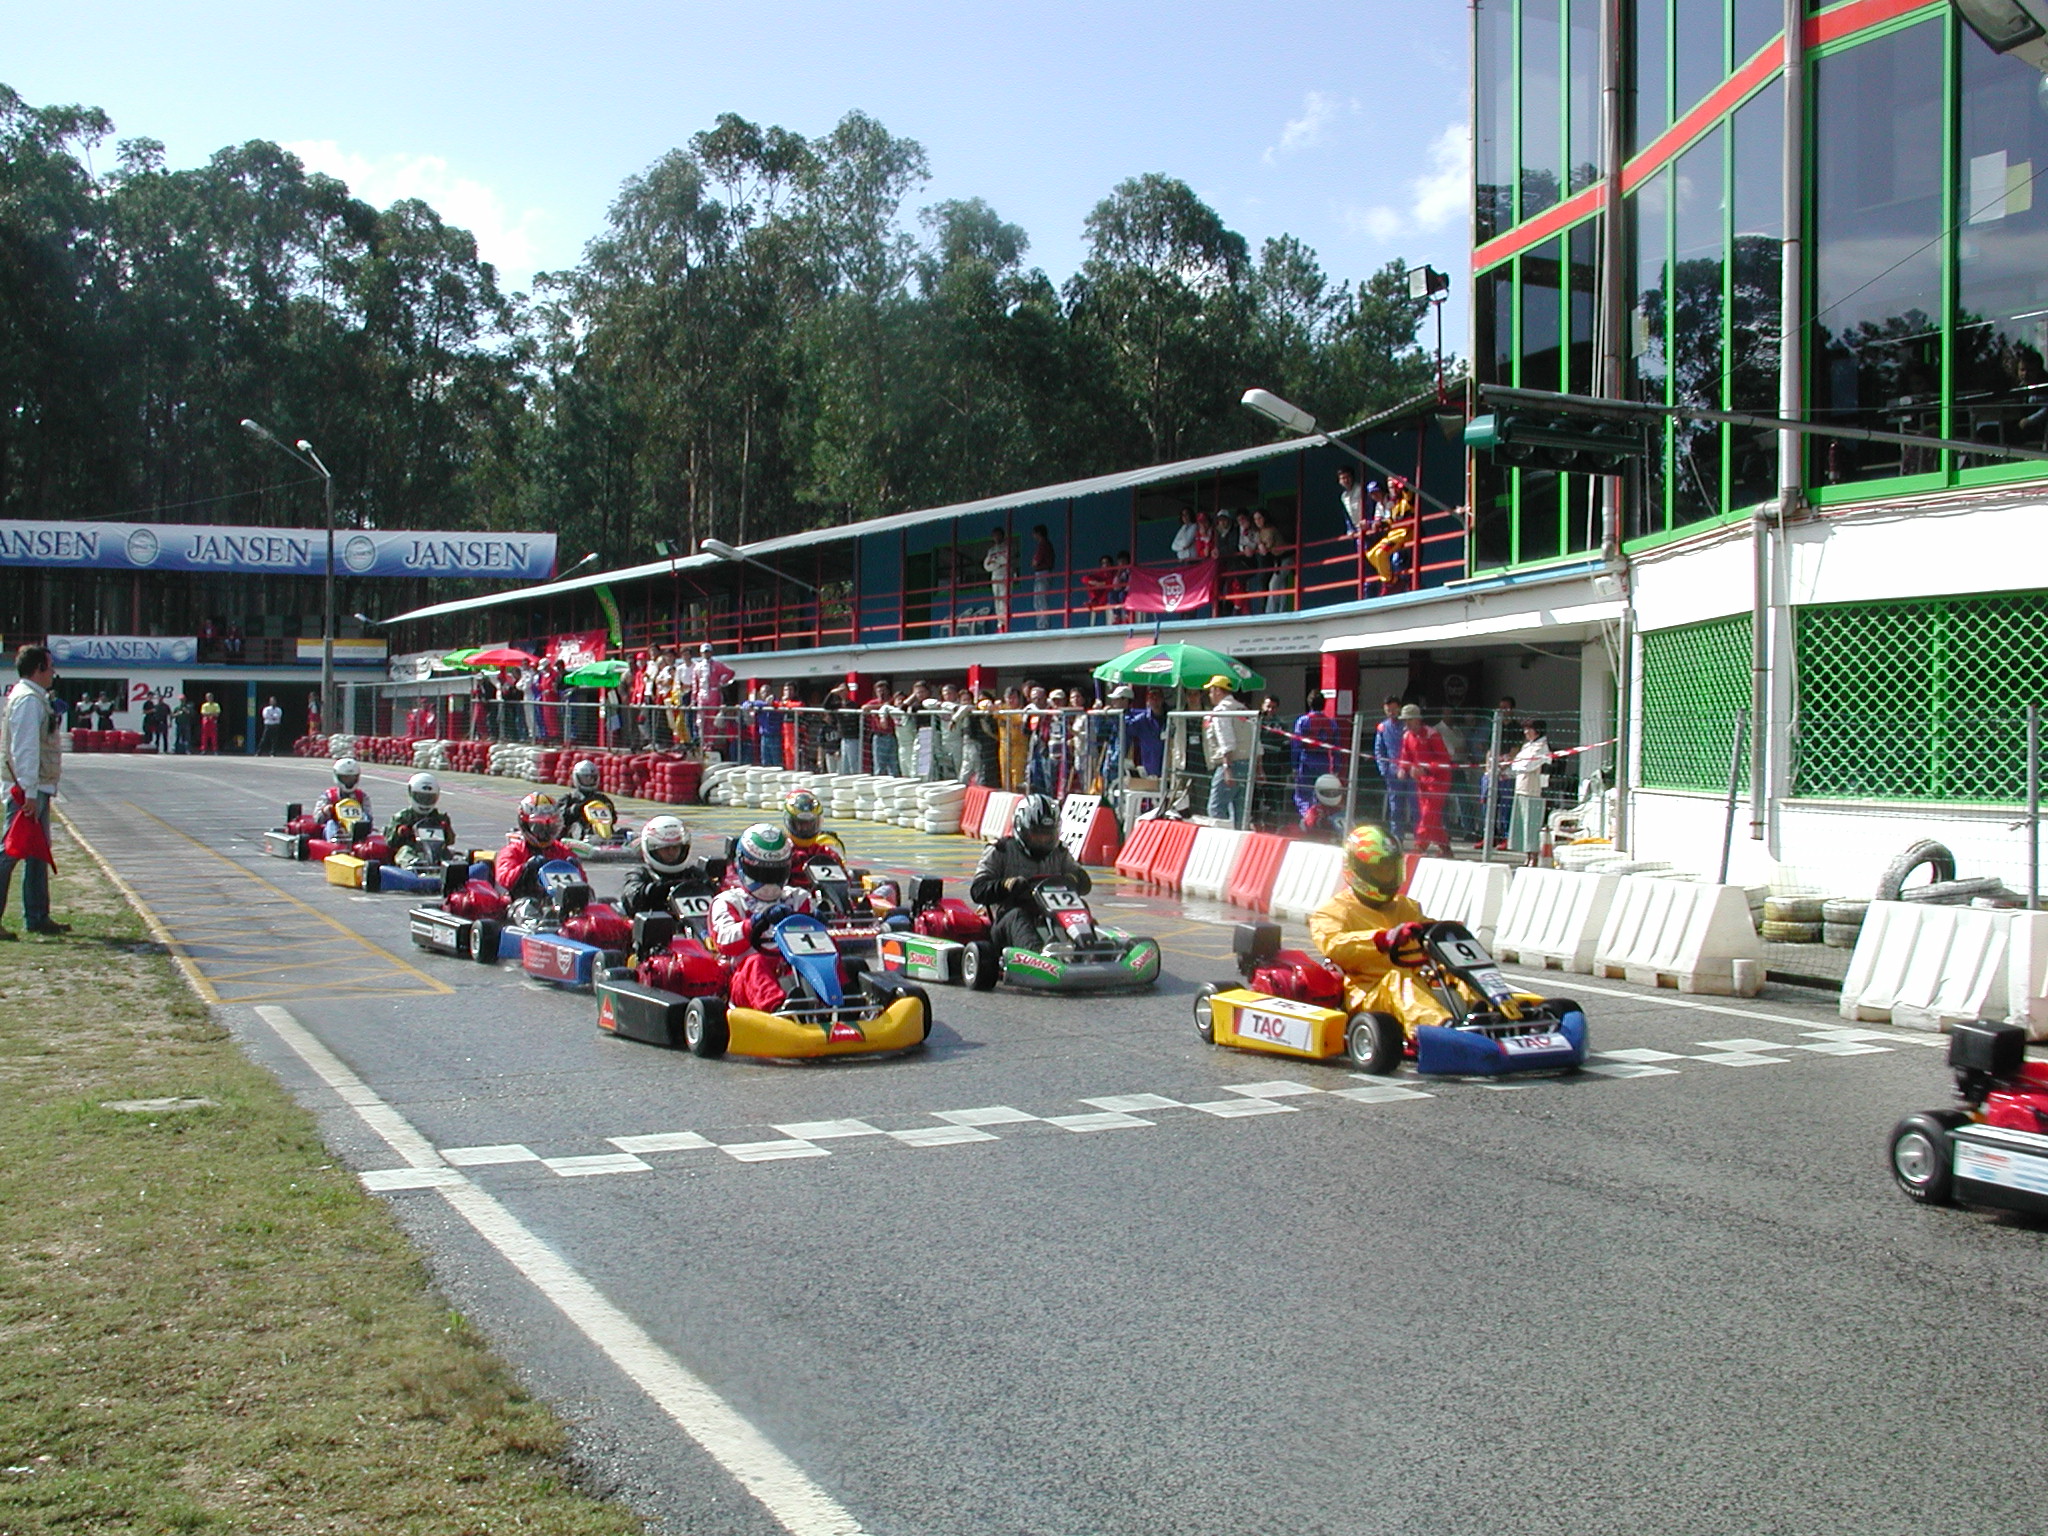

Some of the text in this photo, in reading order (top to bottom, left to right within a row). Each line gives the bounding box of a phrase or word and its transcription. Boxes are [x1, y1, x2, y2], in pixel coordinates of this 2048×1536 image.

[187, 535, 312, 564] JANSEN
[405, 541, 531, 570] JANSEN
[84, 640, 160, 659] JANSEN
[426, 829, 434, 838] 7
[821, 866, 835, 878] 2
[682, 898, 710, 912] 10
[1047, 893, 1079, 906] 12
[800, 933, 817, 949] 1
[909, 951, 937, 968] SUMOL
[1456, 943, 1477, 960] 9
[1011, 953, 1058, 976] SUMOL
